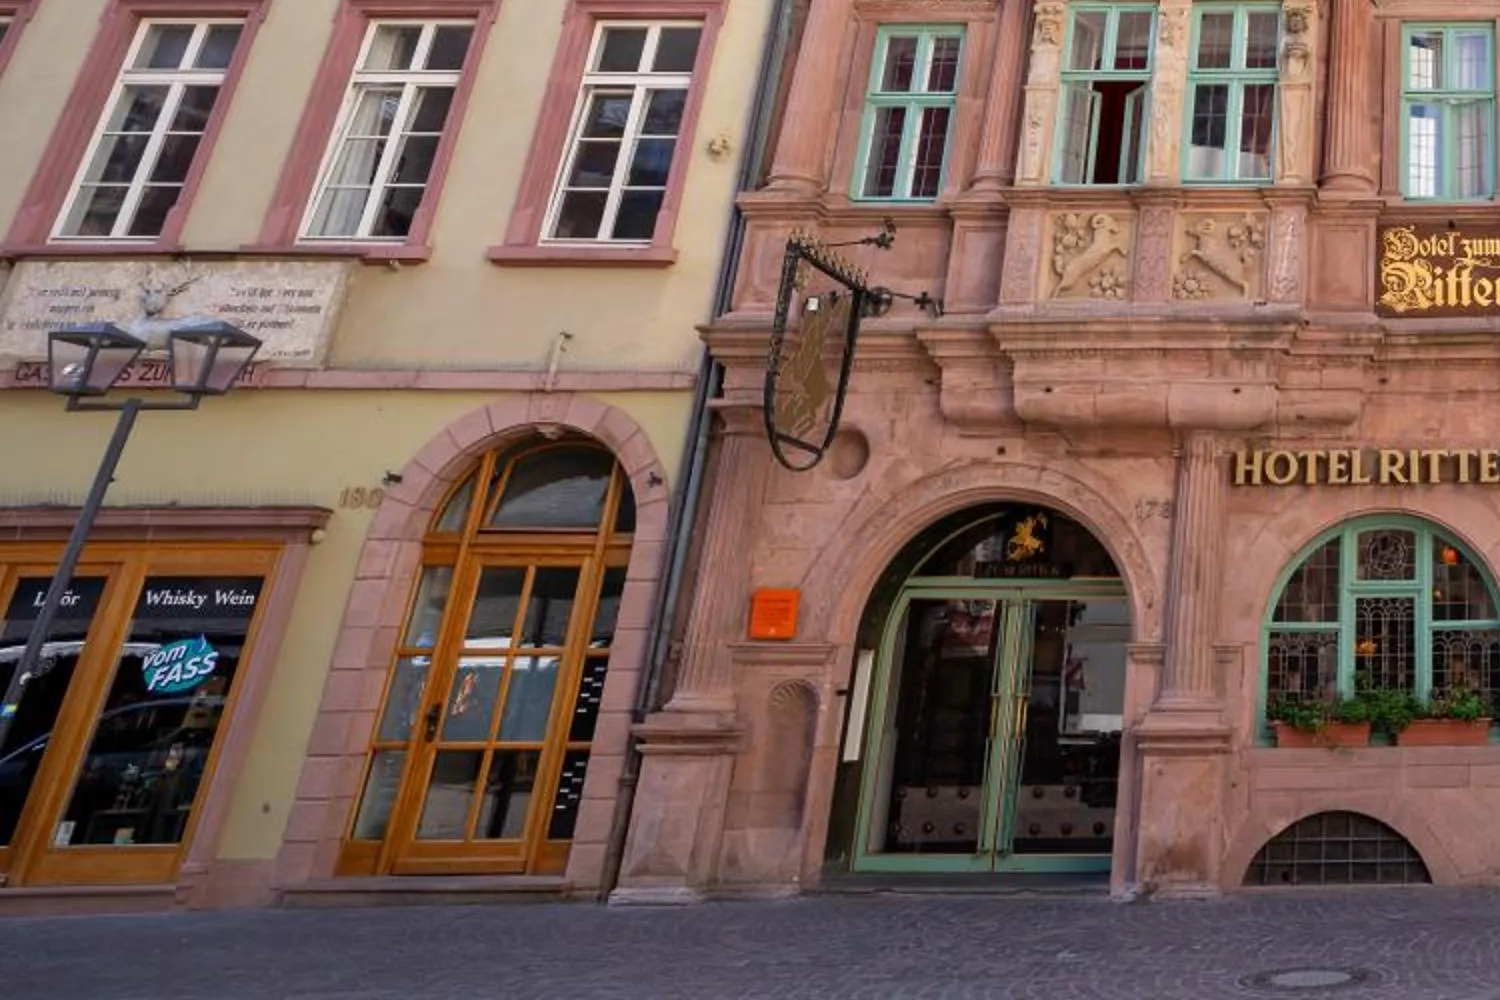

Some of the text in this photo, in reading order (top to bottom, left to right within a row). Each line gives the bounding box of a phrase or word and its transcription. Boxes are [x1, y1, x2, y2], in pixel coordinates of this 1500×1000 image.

[1233, 449, 1371, 486] HOTEL
[32, 590, 80, 607] Lör
[146, 589, 255, 609] Whisky Wein
[147, 650, 220, 691] FASS
